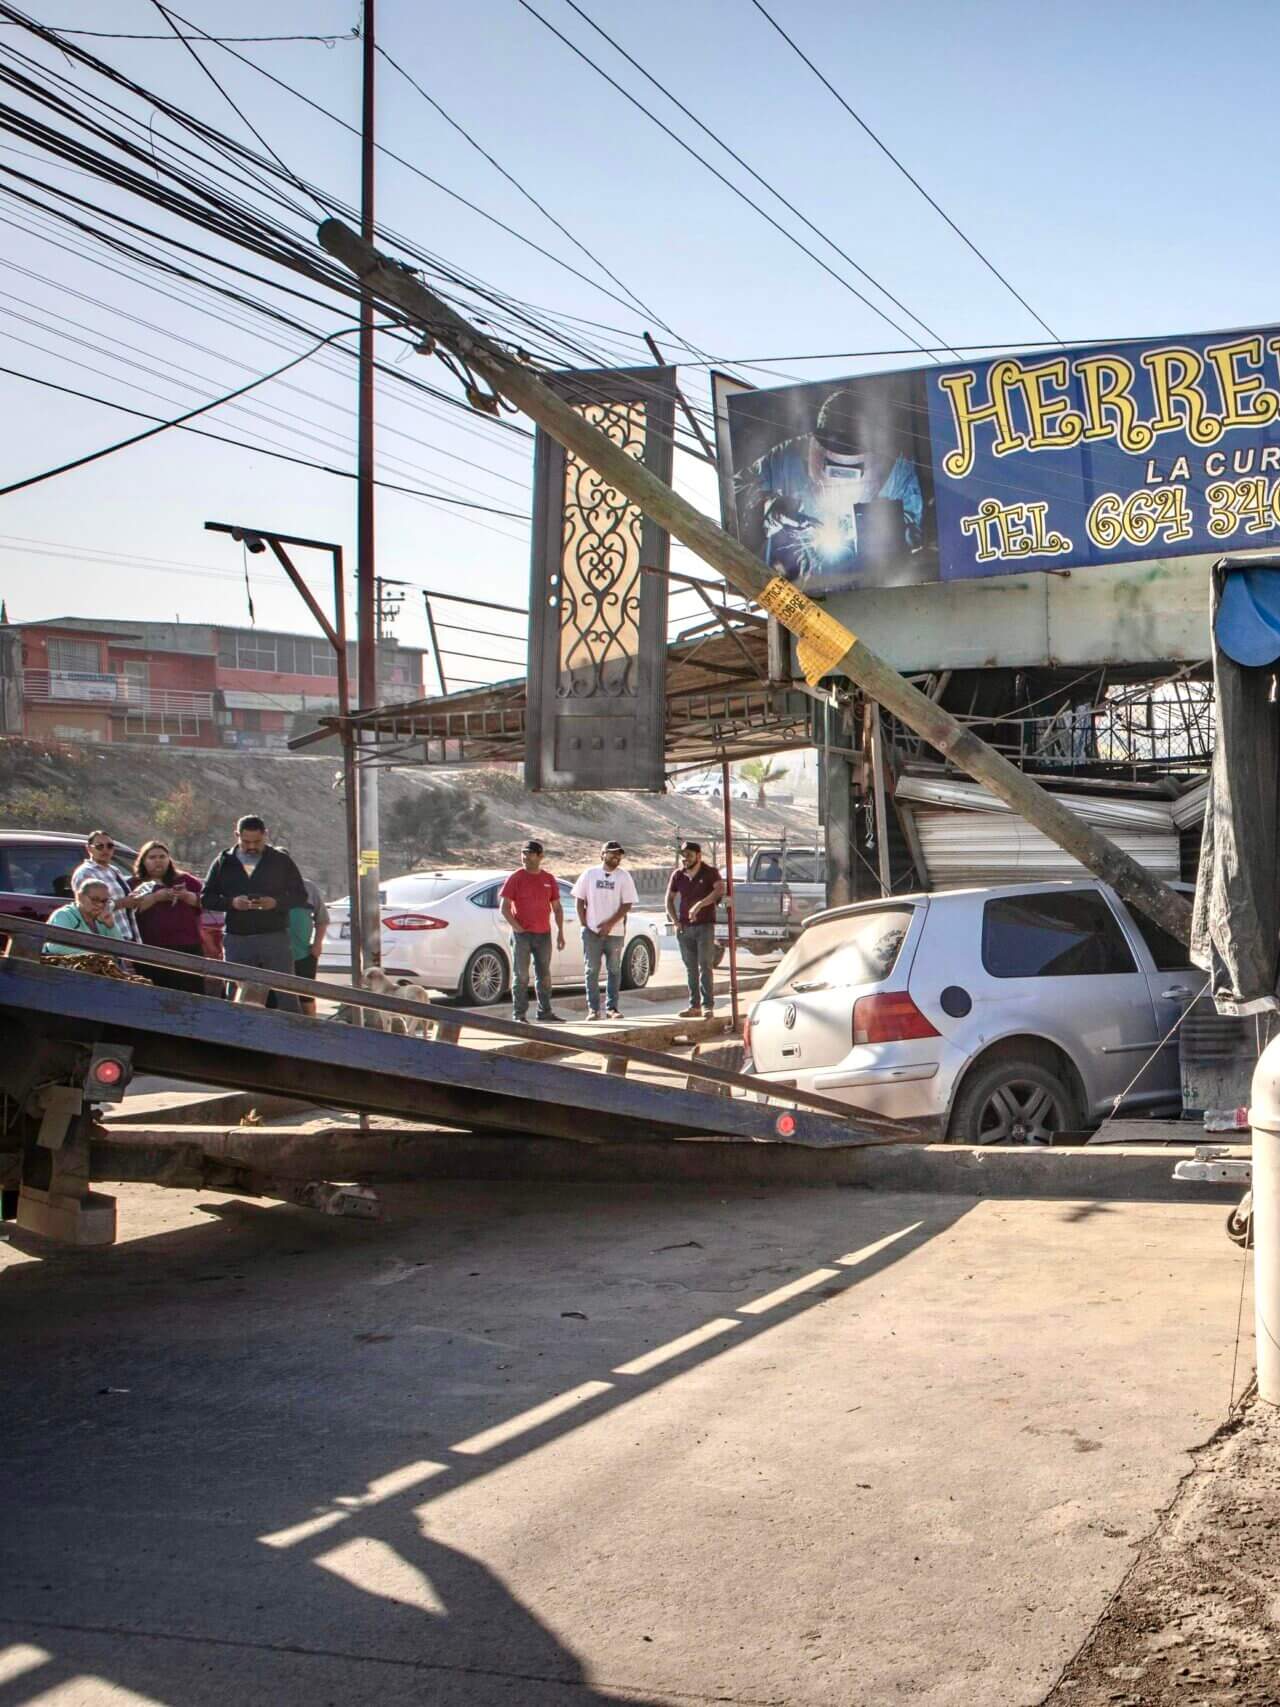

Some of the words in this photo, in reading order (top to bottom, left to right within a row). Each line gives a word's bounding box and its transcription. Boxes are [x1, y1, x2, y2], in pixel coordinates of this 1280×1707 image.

[1145, 455, 1190, 484] LA
[961, 500, 1073, 562] TEL.
[1086, 481, 1193, 549] 664
